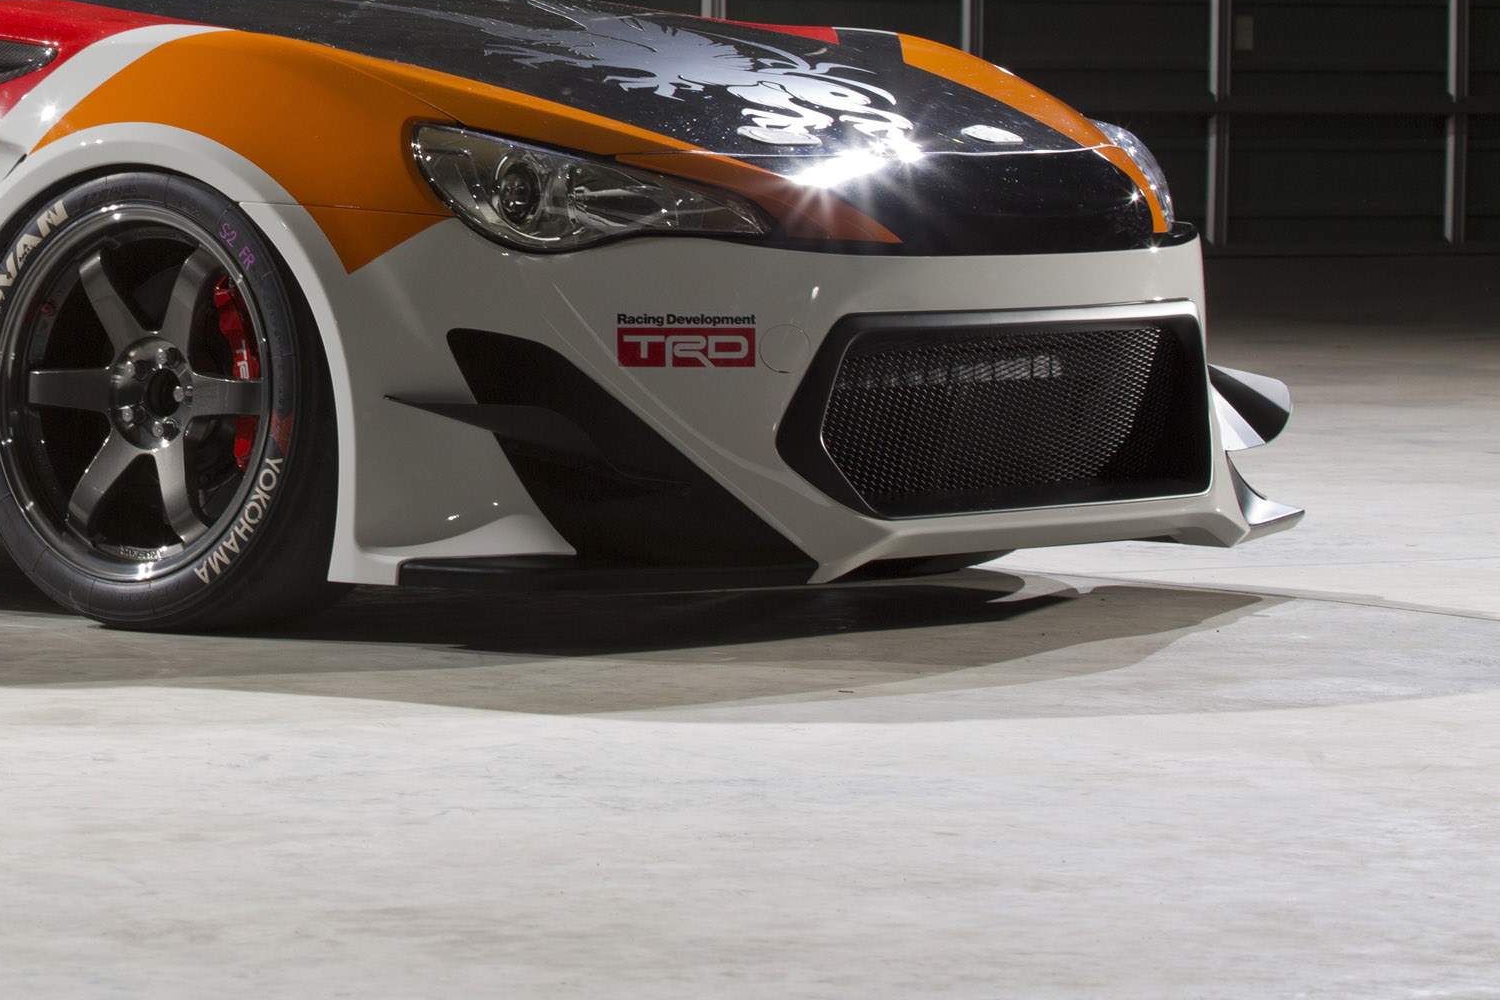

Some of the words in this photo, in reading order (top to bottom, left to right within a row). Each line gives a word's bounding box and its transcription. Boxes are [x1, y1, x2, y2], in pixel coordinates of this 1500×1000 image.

[239, 245, 255, 271] FR
[617, 313, 664, 326] Racing
[666, 313, 756, 326] Development
[236, 340, 250, 380] TR
[623, 335, 749, 367] TRD
[193, 457, 284, 584] YOKOHAMA
